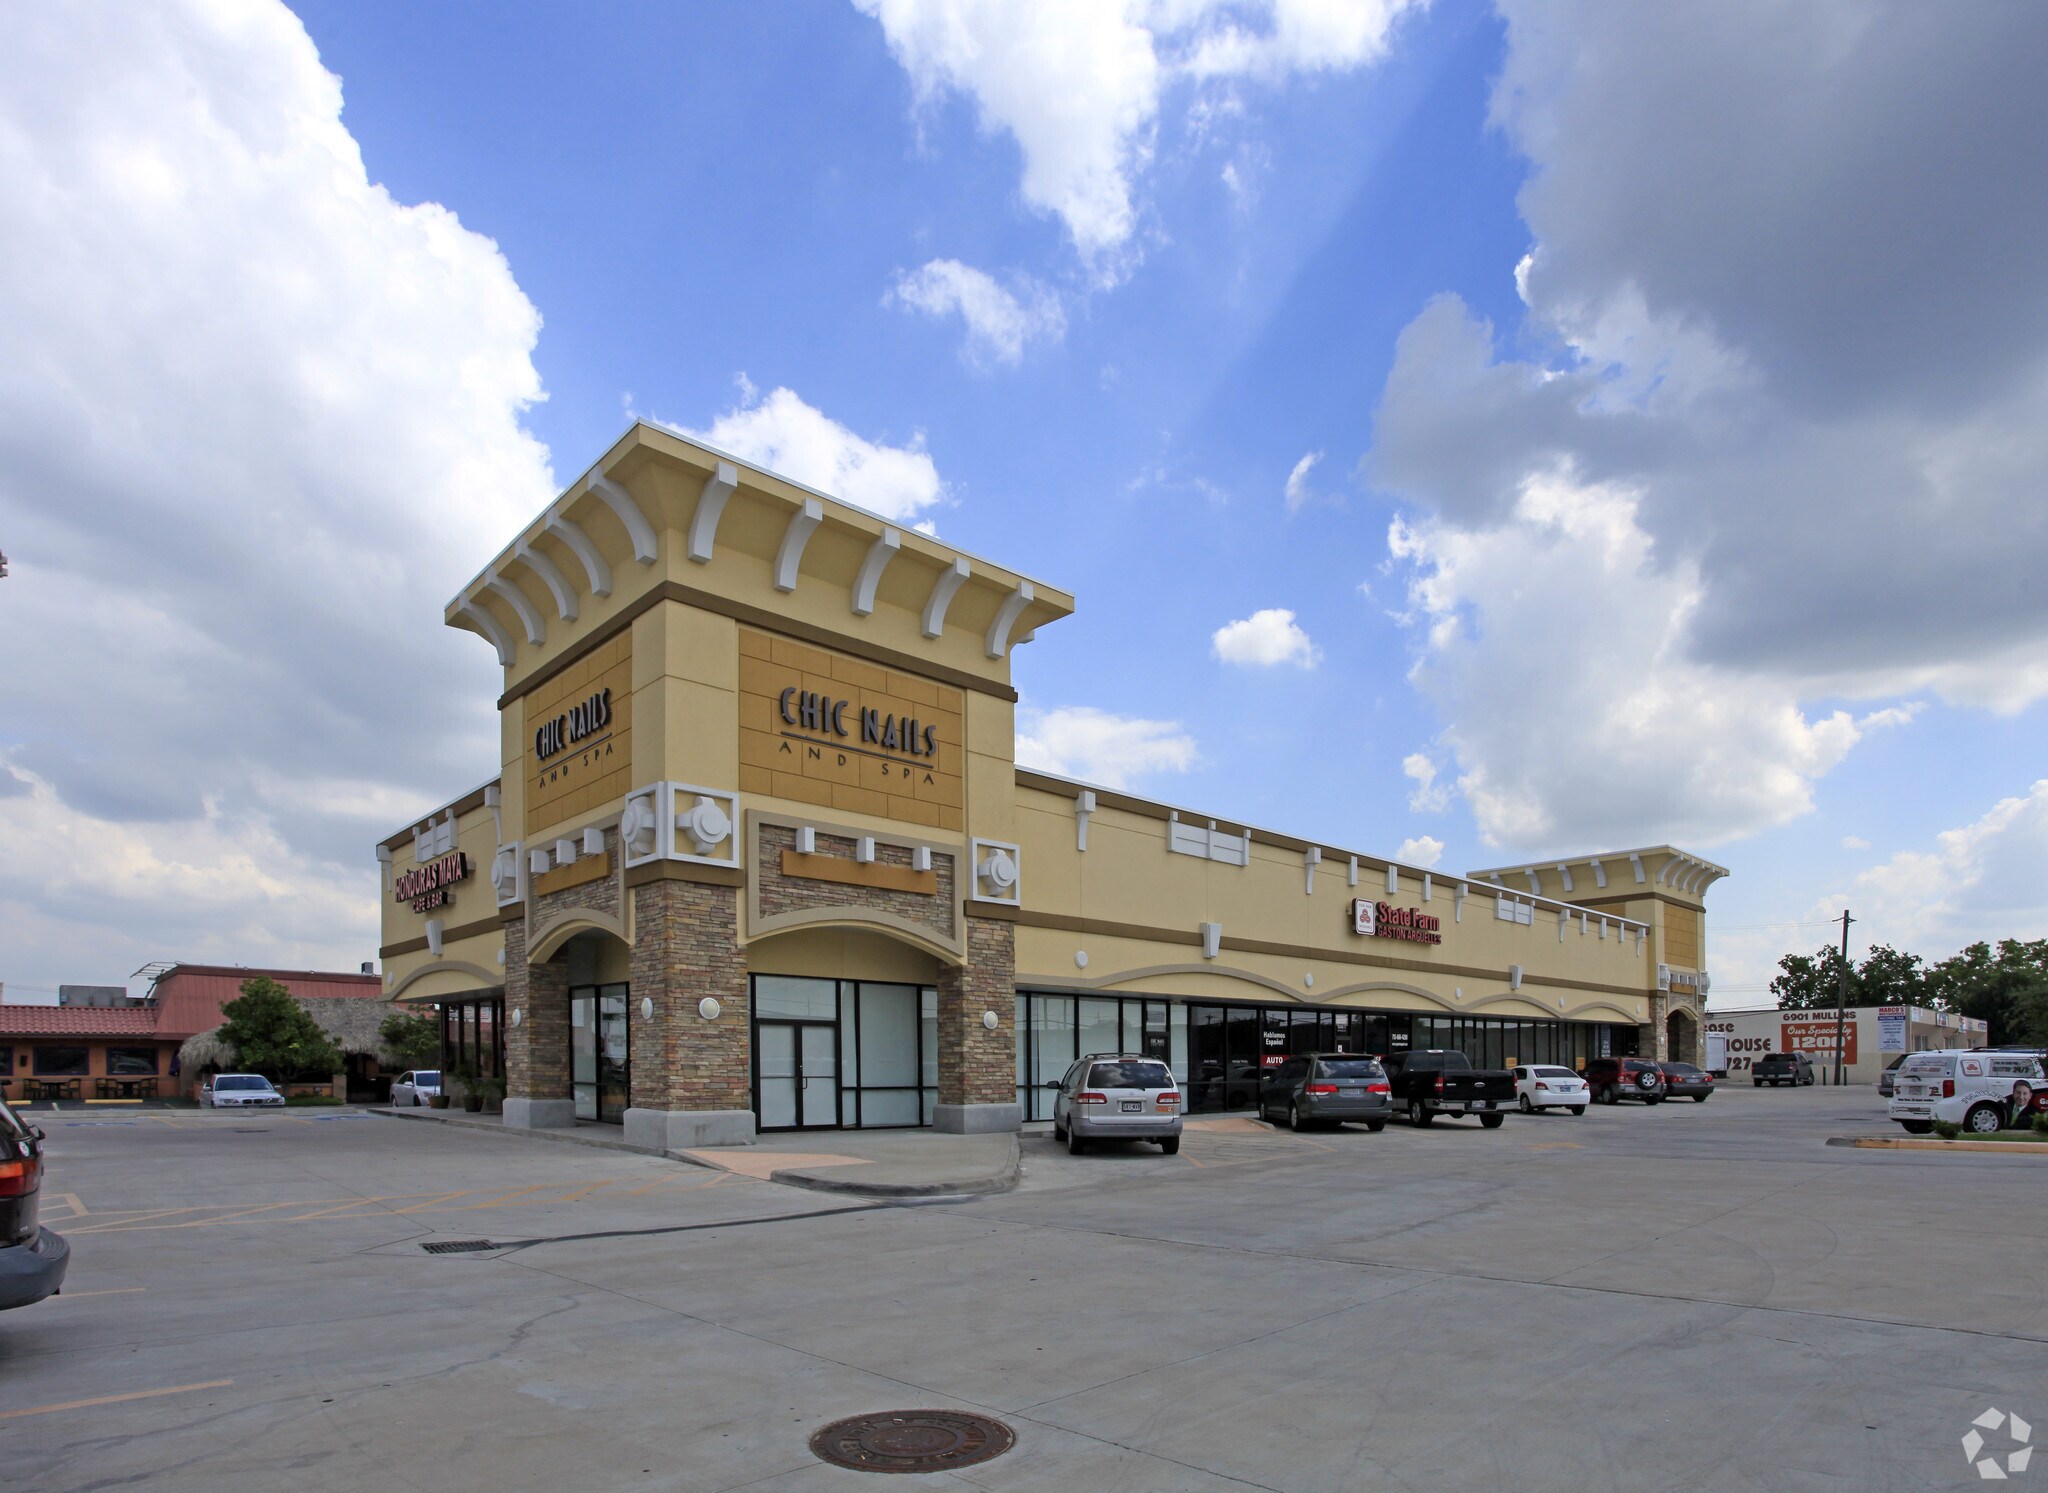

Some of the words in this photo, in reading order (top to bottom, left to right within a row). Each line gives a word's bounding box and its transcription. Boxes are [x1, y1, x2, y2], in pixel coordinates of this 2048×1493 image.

[535, 715, 565, 761] CHIC
[568, 688, 612, 743] NAILS
[781, 687, 848, 737] CHIC
[861, 706, 937, 757] NAILS
[540, 765, 568, 788] AND
[584, 742, 613, 766] SPA
[779, 741, 847, 766] AND
[882, 763, 934, 785] SPA
[395, 864, 438, 902] HONDURAS
[438, 852, 464, 886] MAYA
[1378, 901, 1411, 927] State
[1411, 907, 1440, 931] Farm
[1378, 925, 1406, 940] GASTON
[1407, 929, 1442, 945] ARGUELLES
[1783, 1013, 1808, 1021] 6901
[1812, 1011, 1856, 1020] MULLNS
[1263, 1031, 1286, 1039] Hablamos
[1265, 1038, 1284, 1047] Español
[1787, 1025, 1806, 1035] Our
[1807, 1024, 1852, 1037] Speciaty
[1266, 1056, 1283, 1064] AUTO
